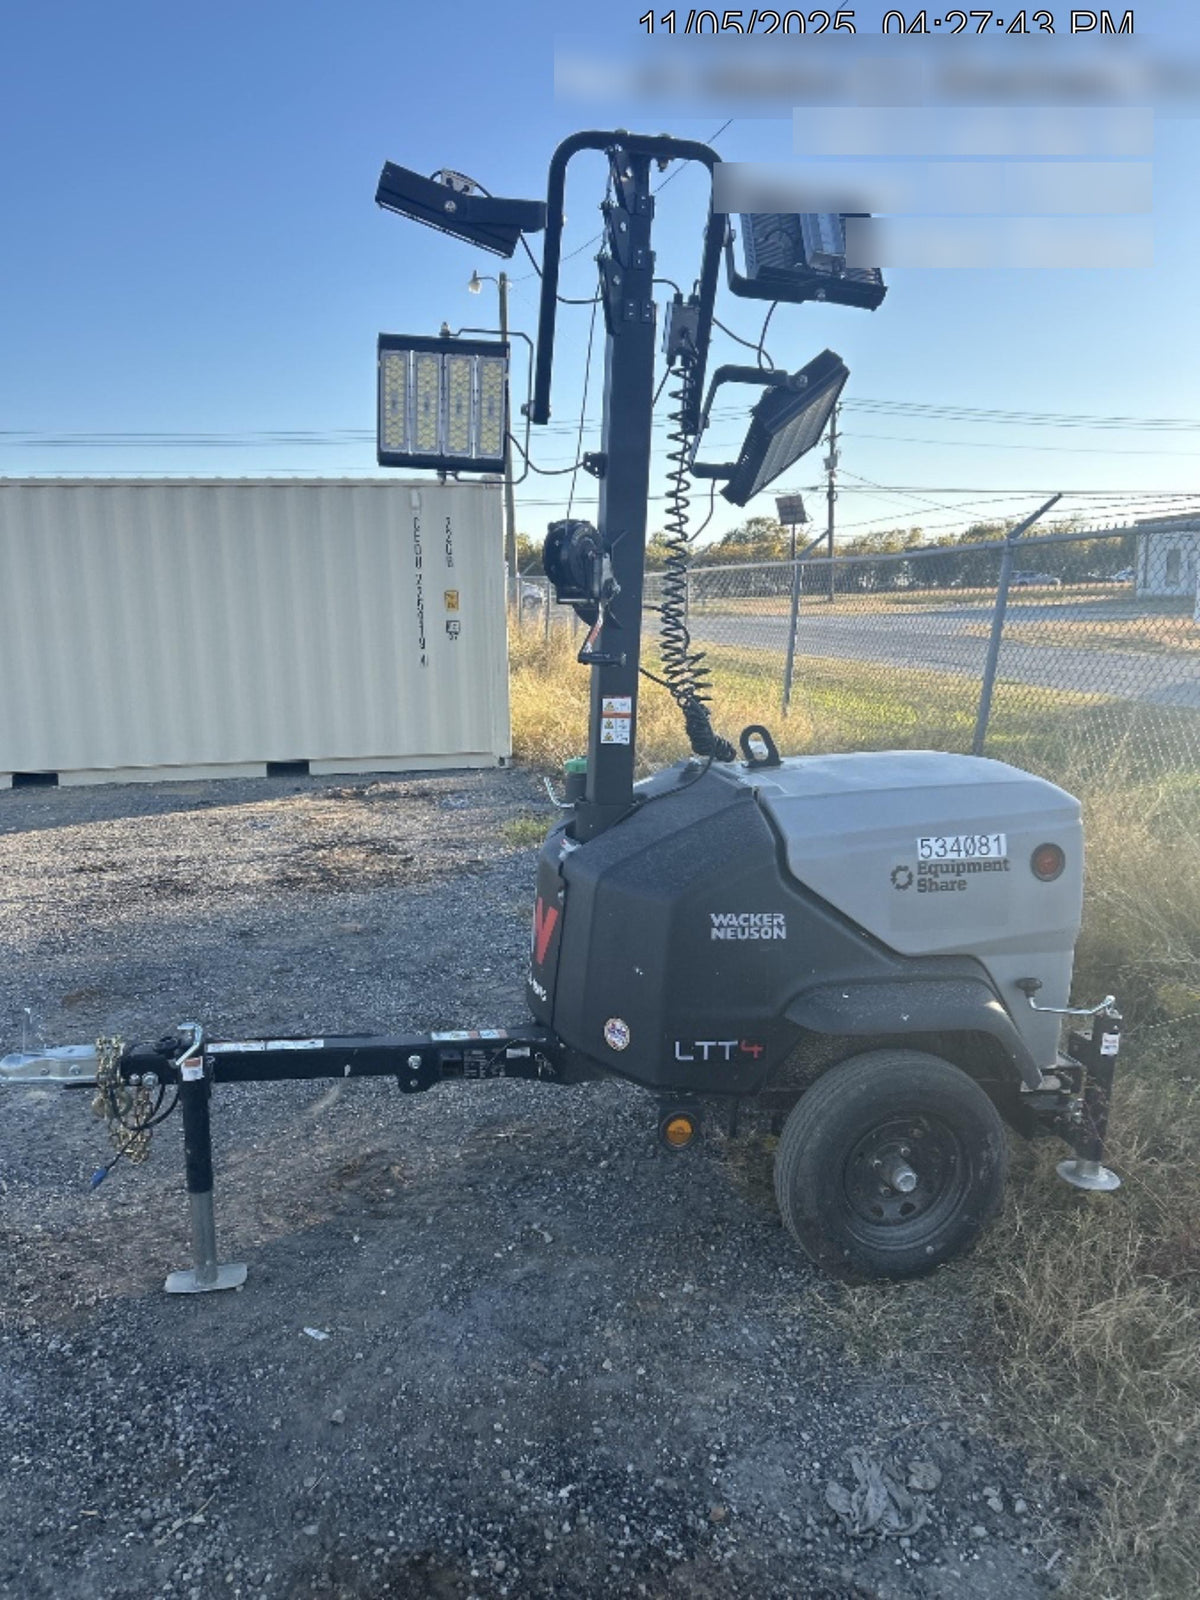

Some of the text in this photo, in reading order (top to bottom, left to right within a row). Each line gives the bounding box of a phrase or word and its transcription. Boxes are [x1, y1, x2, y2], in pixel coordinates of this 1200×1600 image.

[919, 834, 1002, 859] 534081
[917, 859, 1010, 878] Equipment
[917, 877, 967, 893] Share
[710, 912, 786, 926] WACKER
[711, 926, 787, 940] NEUSON
[674, 1039, 763, 1061] LTT4
